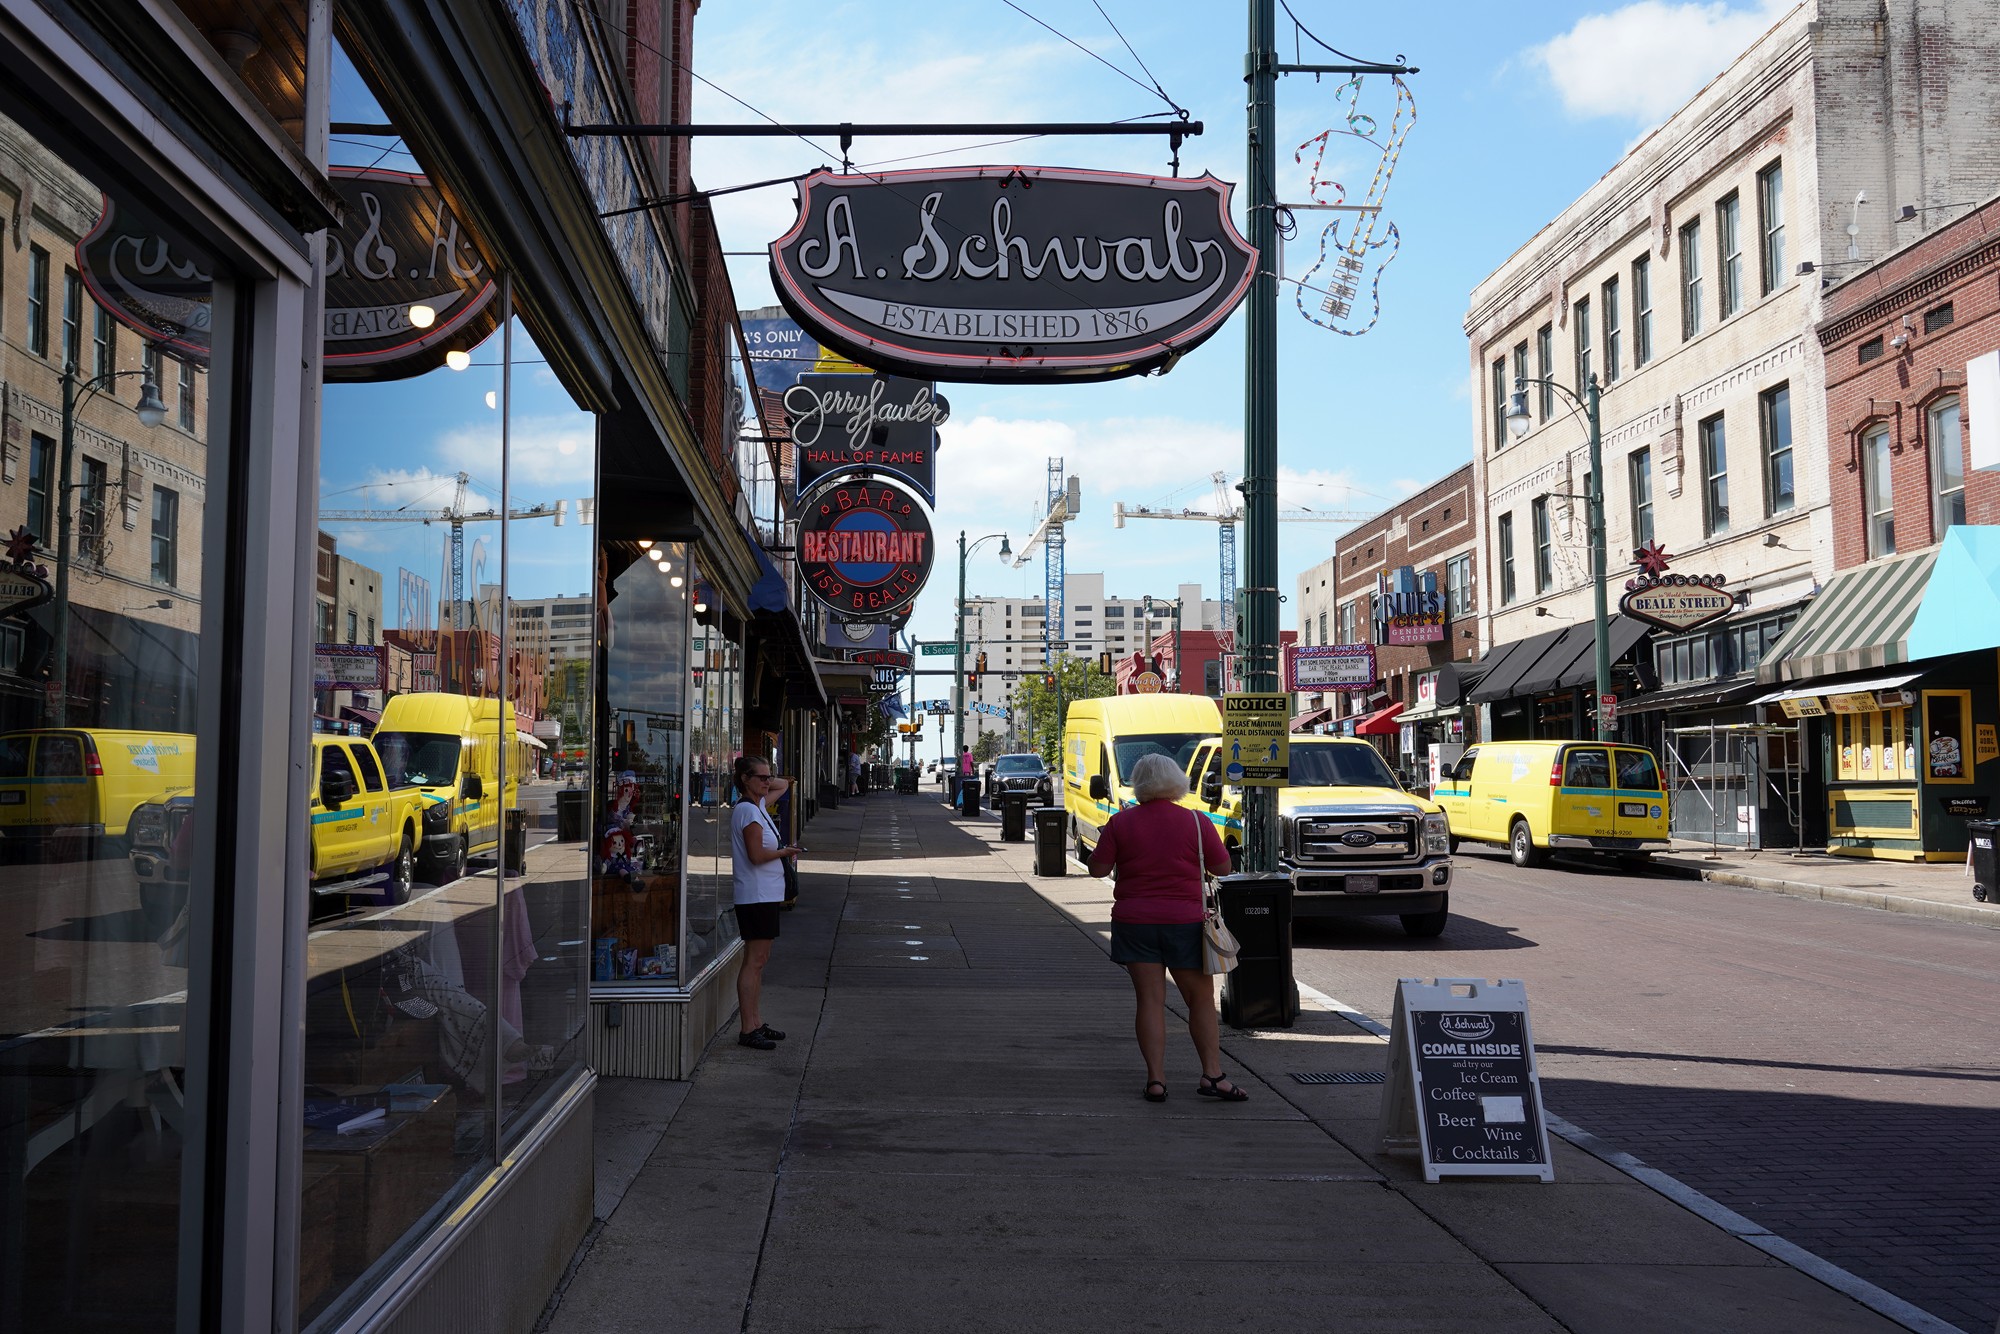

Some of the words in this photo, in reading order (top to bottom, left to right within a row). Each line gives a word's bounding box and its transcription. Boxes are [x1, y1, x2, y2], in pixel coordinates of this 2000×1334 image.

[798, 194, 887, 280] A.
[902, 191, 1228, 282] Schwab
[881, 303, 1081, 339] ESTABLISHED
[1090, 308, 1150, 338] 1876
[766, 329, 803, 343] ONLY
[784, 386, 867, 447] Jerry
[850, 380, 950, 450] Lawler
[807, 451, 849, 463] HALL
[854, 451, 873, 463] OF
[882, 451, 924, 463] FAME
[836, 487, 894, 511] BAR
[803, 531, 926, 563] RESTAURANT
[1638, 576, 1723, 587] WELCOME
[812, 569, 843, 597] 159
[853, 569, 917, 608] BEALE
[1383, 591, 1440, 623] BLUES
[1636, 598, 1675, 609] BEALE
[1680, 597, 1726, 608] STREET
[1394, 614, 1442, 628] CITY
[1392, 627, 1439, 636] GENERAL
[1400, 634, 1432, 642] STORE
[924, 646, 931, 655] S.
[932, 646, 957, 654] Second
[1129, 676, 1148, 685] Hard
[969, 701, 1008, 719] LUES
[1228, 699, 1284, 710] NOTICE
[1800, 708, 1822, 716] BEER
[1228, 720, 1250, 728] PLEASE
[1251, 720, 1282, 728] MAINTAIN
[1349, 834, 1369, 843] Ford
[1455, 1016, 1490, 1029] Schwab
[1422, 1043, 1467, 1055] COME
[1471, 1044, 1521, 1055] INSIDE
[1468, 1061, 1479, 1069] try
[1460, 1072, 1477, 1083] Ice
[1480, 1072, 1518, 1083] Cream
[1431, 1087, 1476, 1100] Coffee
[1438, 1113, 1476, 1127] Beer
[1483, 1128, 1522, 1141] Wine
[1452, 1146, 1519, 1160] Cocktails
